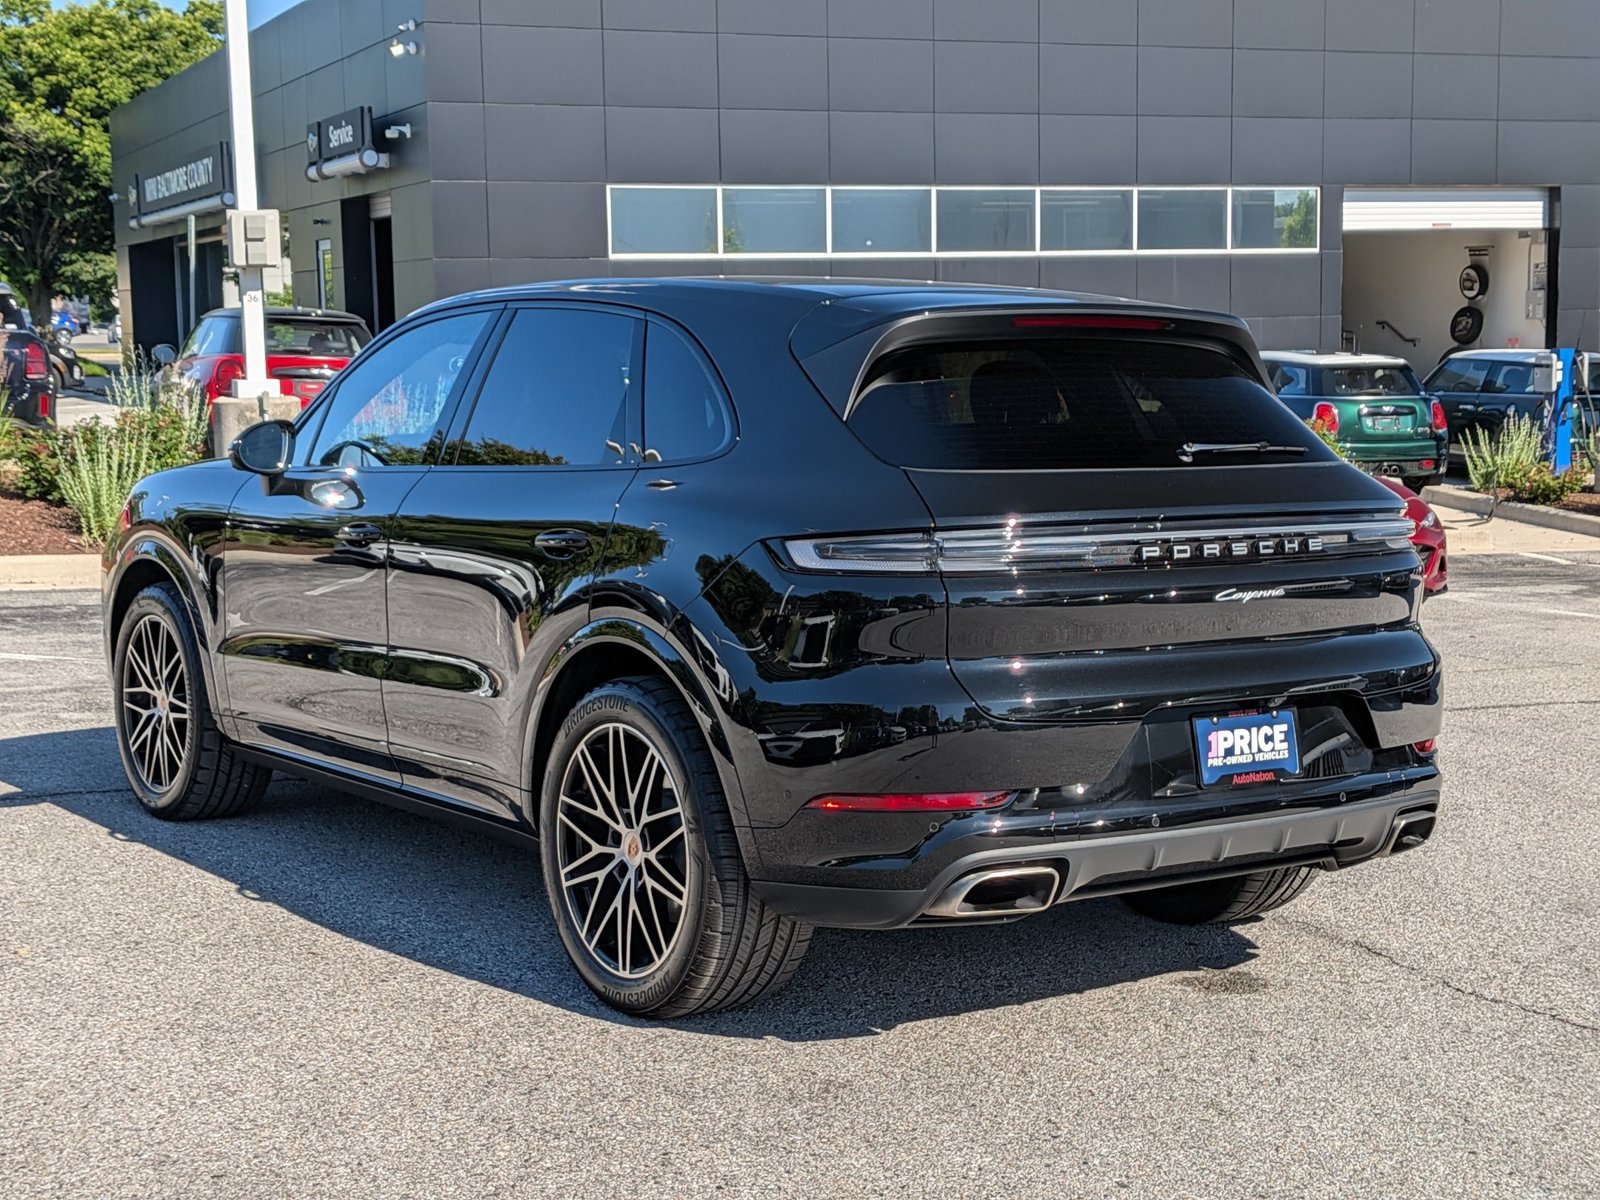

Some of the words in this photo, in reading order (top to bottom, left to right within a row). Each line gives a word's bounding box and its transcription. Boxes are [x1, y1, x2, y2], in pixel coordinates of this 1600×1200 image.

[328, 120, 354, 148] Service
[157, 165, 188, 199] BALTIMORE
[187, 156, 213, 190] COUNTY
[247, 294, 259, 302] 36
[1141, 538, 1323, 560] PORSCHE
[1215, 586, 1286, 604] Cayenne
[563, 694, 632, 740] BRIDGESTONE
[1207, 753, 1253, 768] PRE-OWNED
[1254, 749, 1289, 762] VEHICLES
[1232, 771, 1275, 785] AutoNation
